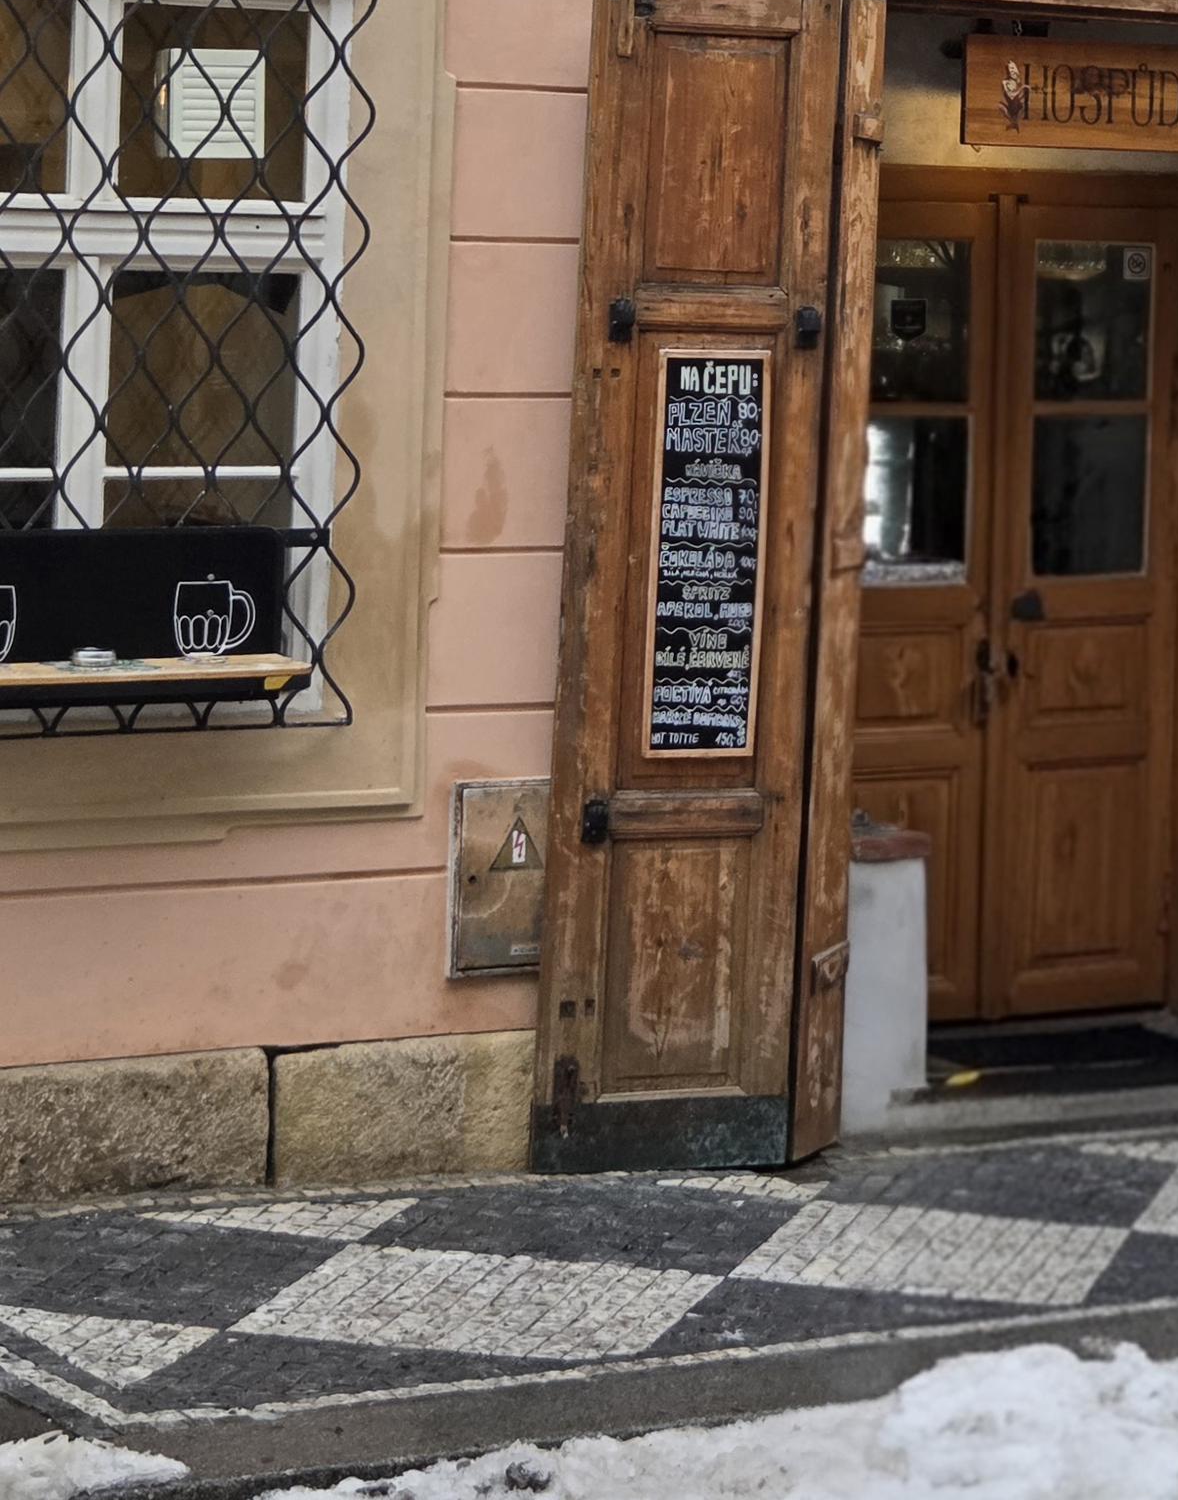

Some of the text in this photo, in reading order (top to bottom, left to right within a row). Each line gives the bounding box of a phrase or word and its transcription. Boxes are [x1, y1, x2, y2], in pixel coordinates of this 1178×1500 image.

[680, 361, 758, 394] NA ČEPU:
[666, 428, 741, 453] MASTER
[664, 487, 733, 506] ESPRESSO
[662, 520, 697, 537] FLAT
[697, 520, 740, 540] WHITE
[682, 585, 731, 600] SPRITZ
